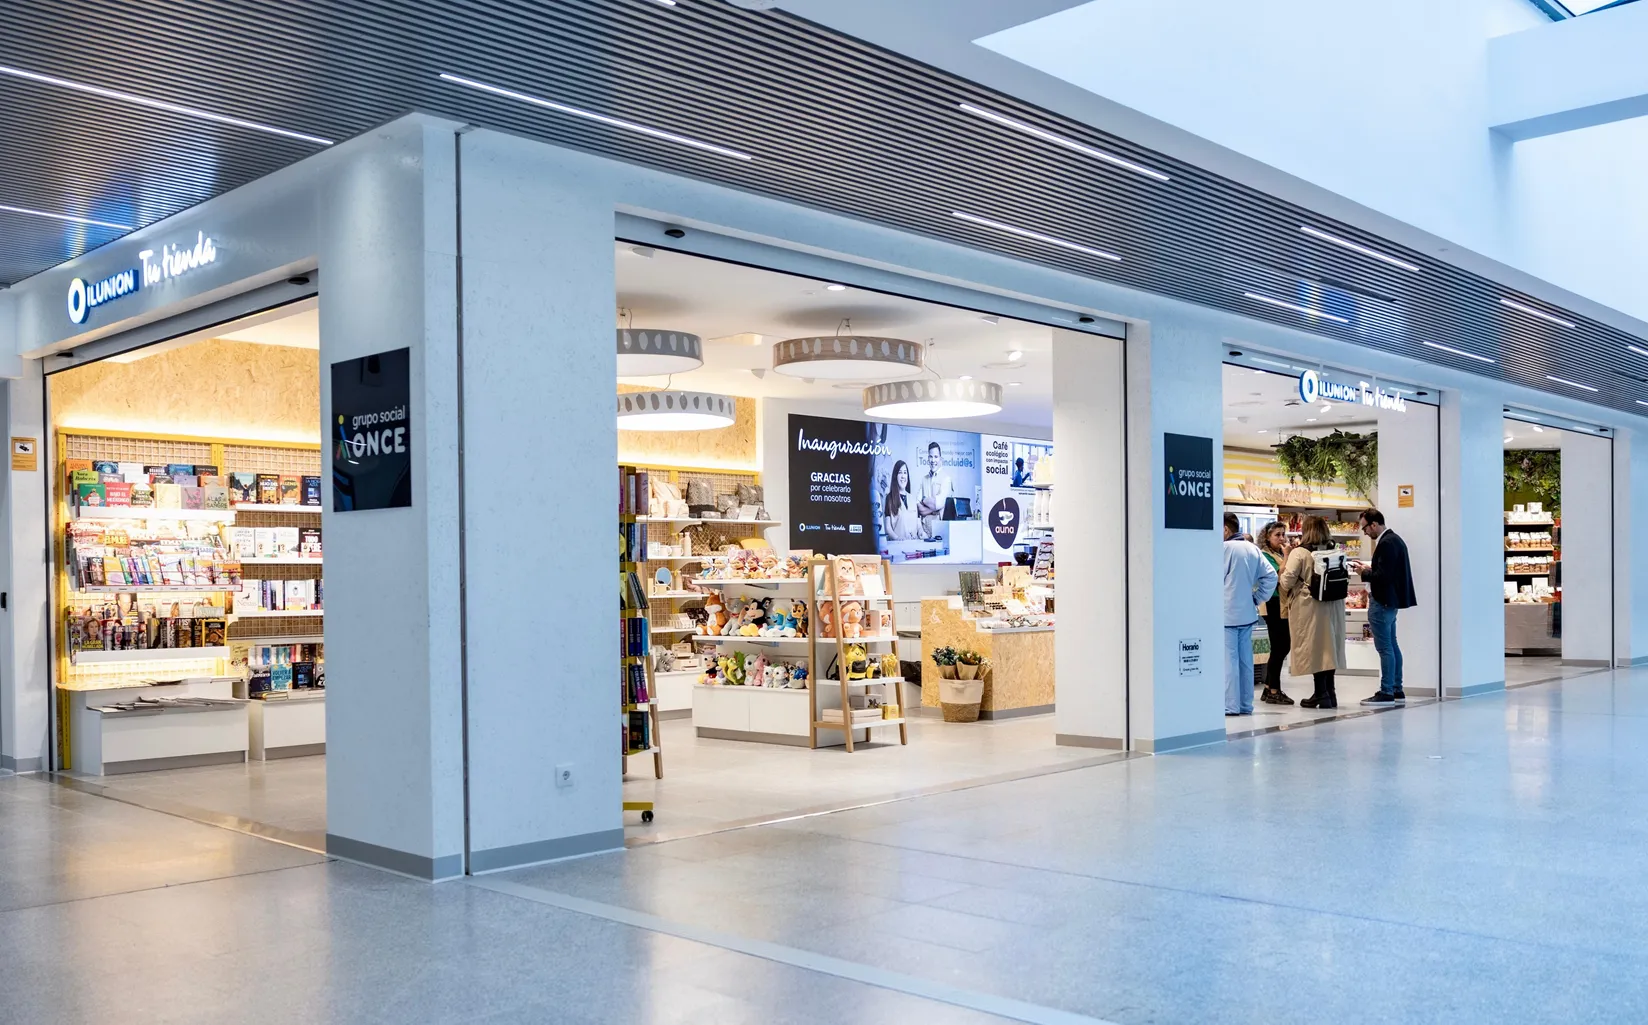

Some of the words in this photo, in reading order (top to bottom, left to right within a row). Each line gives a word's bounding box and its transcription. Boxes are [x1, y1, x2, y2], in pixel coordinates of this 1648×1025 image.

[87, 269, 134, 307] ILUNION
[139, 249, 161, 287] Tu
[162, 230, 216, 278] tienda
[1319, 380, 1356, 402] ILUNION
[1360, 381, 1374, 406] Tu
[1374, 386, 1406, 412] tienda
[352, 414, 378, 430] grupo
[379, 405, 406, 423] social
[352, 426, 406, 458] ONCE
[798, 428, 892, 460] Inauguración
[993, 441, 1009, 450] Café
[986, 464, 1009, 475] social
[1178, 469, 1196, 479] grupo
[1196, 469, 1212, 479] social
[810, 472, 851, 484] GRACIAS
[821, 485, 851, 493] celebrarlo
[1178, 480, 1211, 498] ONCE
[823, 495, 851, 503] nosotros
[995, 526, 1015, 534] auna
[1182, 643, 1199, 651] Horario
